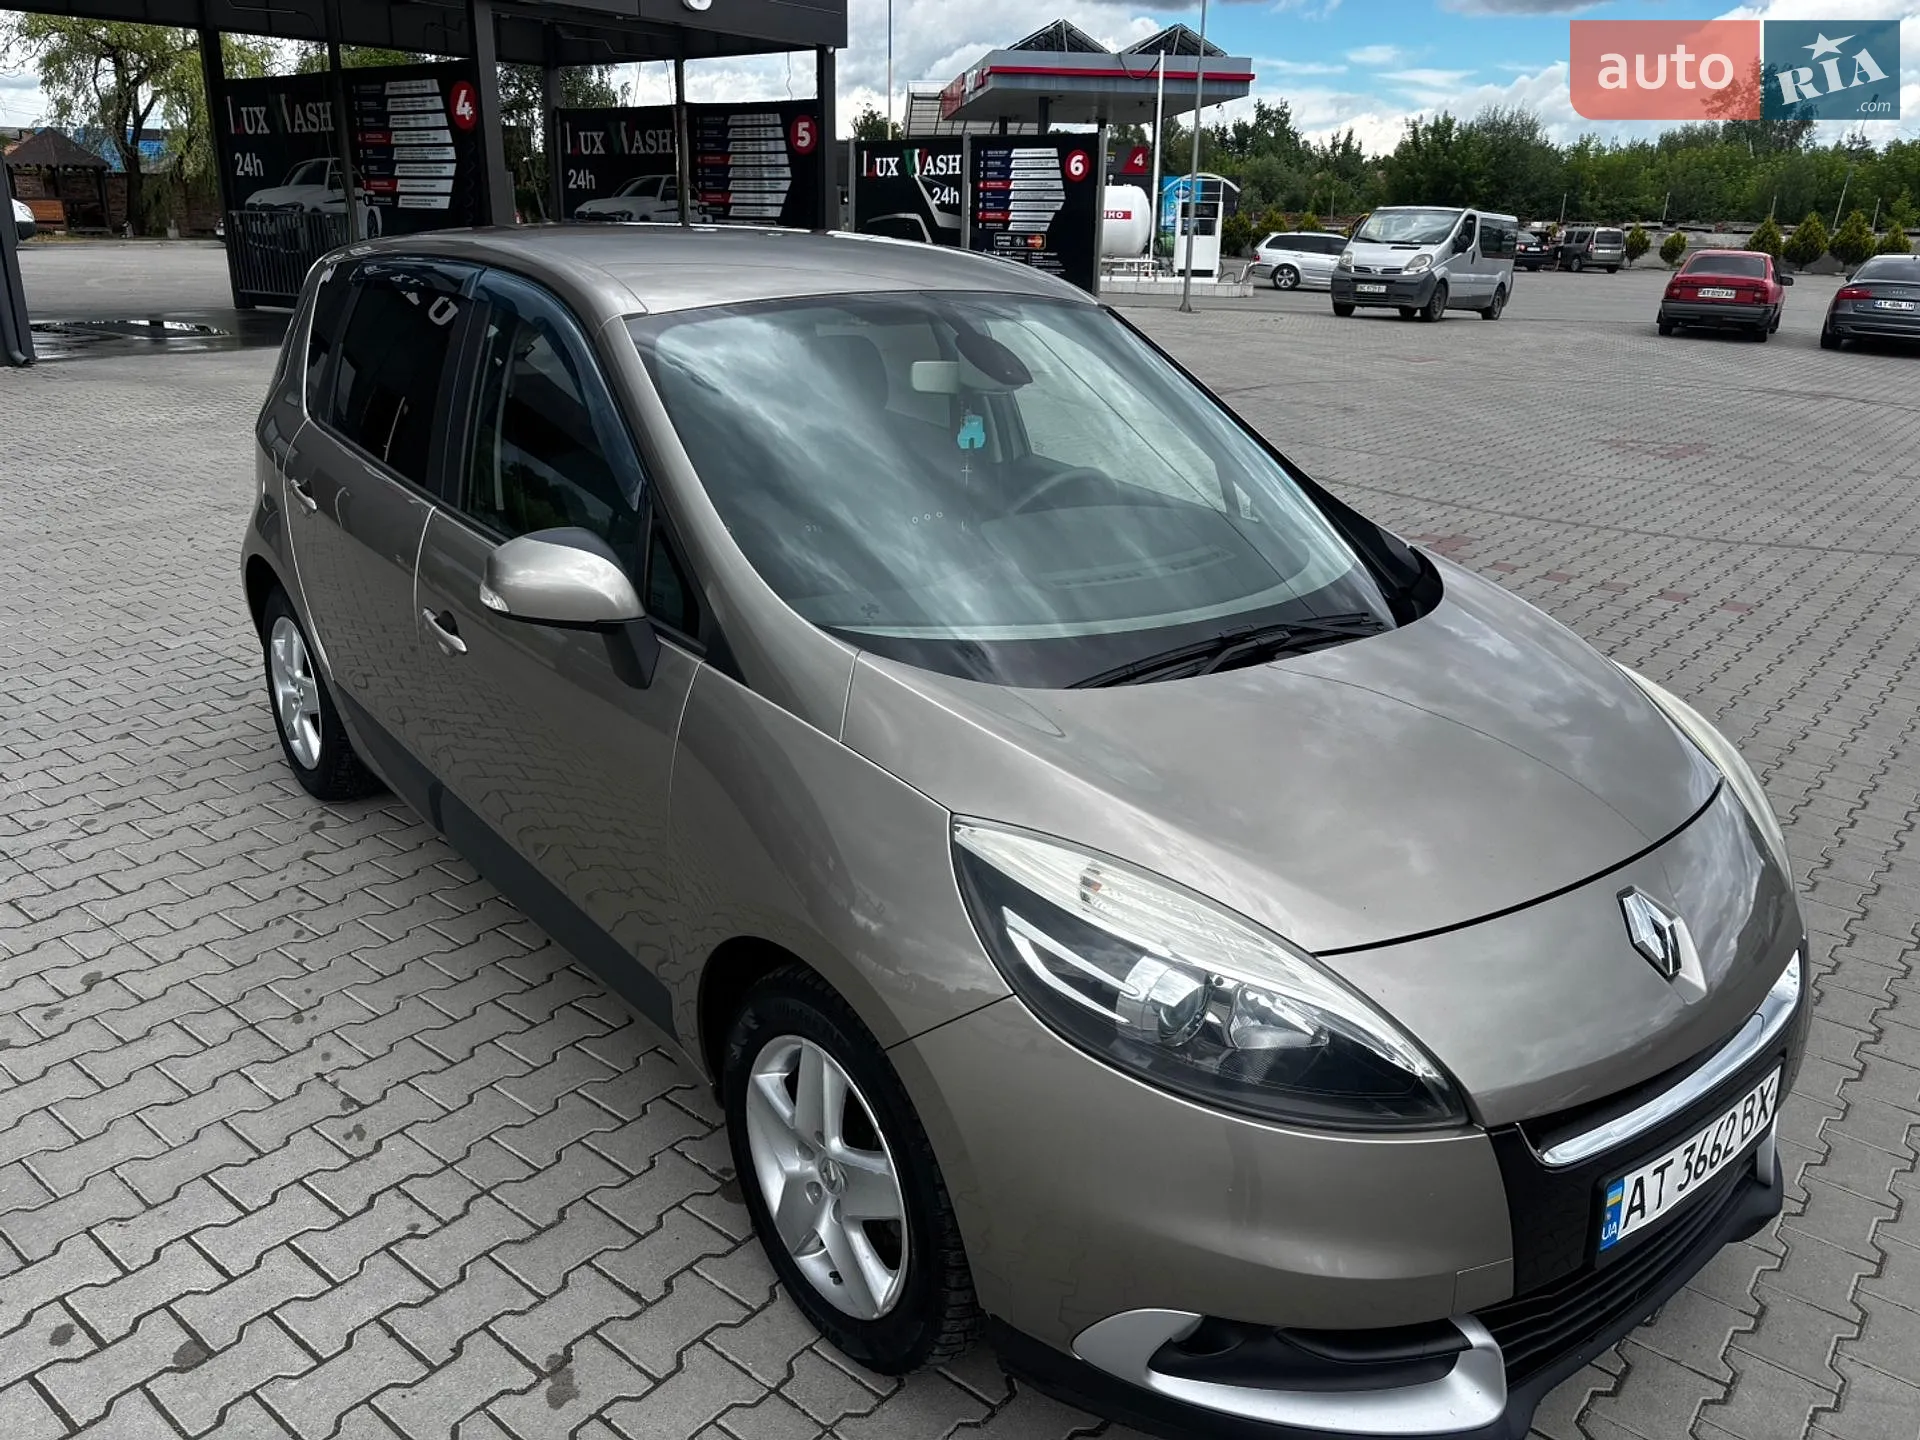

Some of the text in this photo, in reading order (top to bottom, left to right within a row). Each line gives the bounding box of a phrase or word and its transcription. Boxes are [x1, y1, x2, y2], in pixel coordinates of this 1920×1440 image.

[456, 89, 474, 120] 4
[797, 122, 811, 147] 5
[234, 152, 264, 177] 24h
[860, 148, 962, 178] LUX WASH
[1070, 154, 1084, 173] 6
[1134, 153, 1144, 166] 4
[568, 168, 596, 190] 24h
[932, 186, 960, 205] 24h
[1622, 1077, 1776, 1230] AT 3662 BX
[1602, 1223, 1617, 1240] UA
